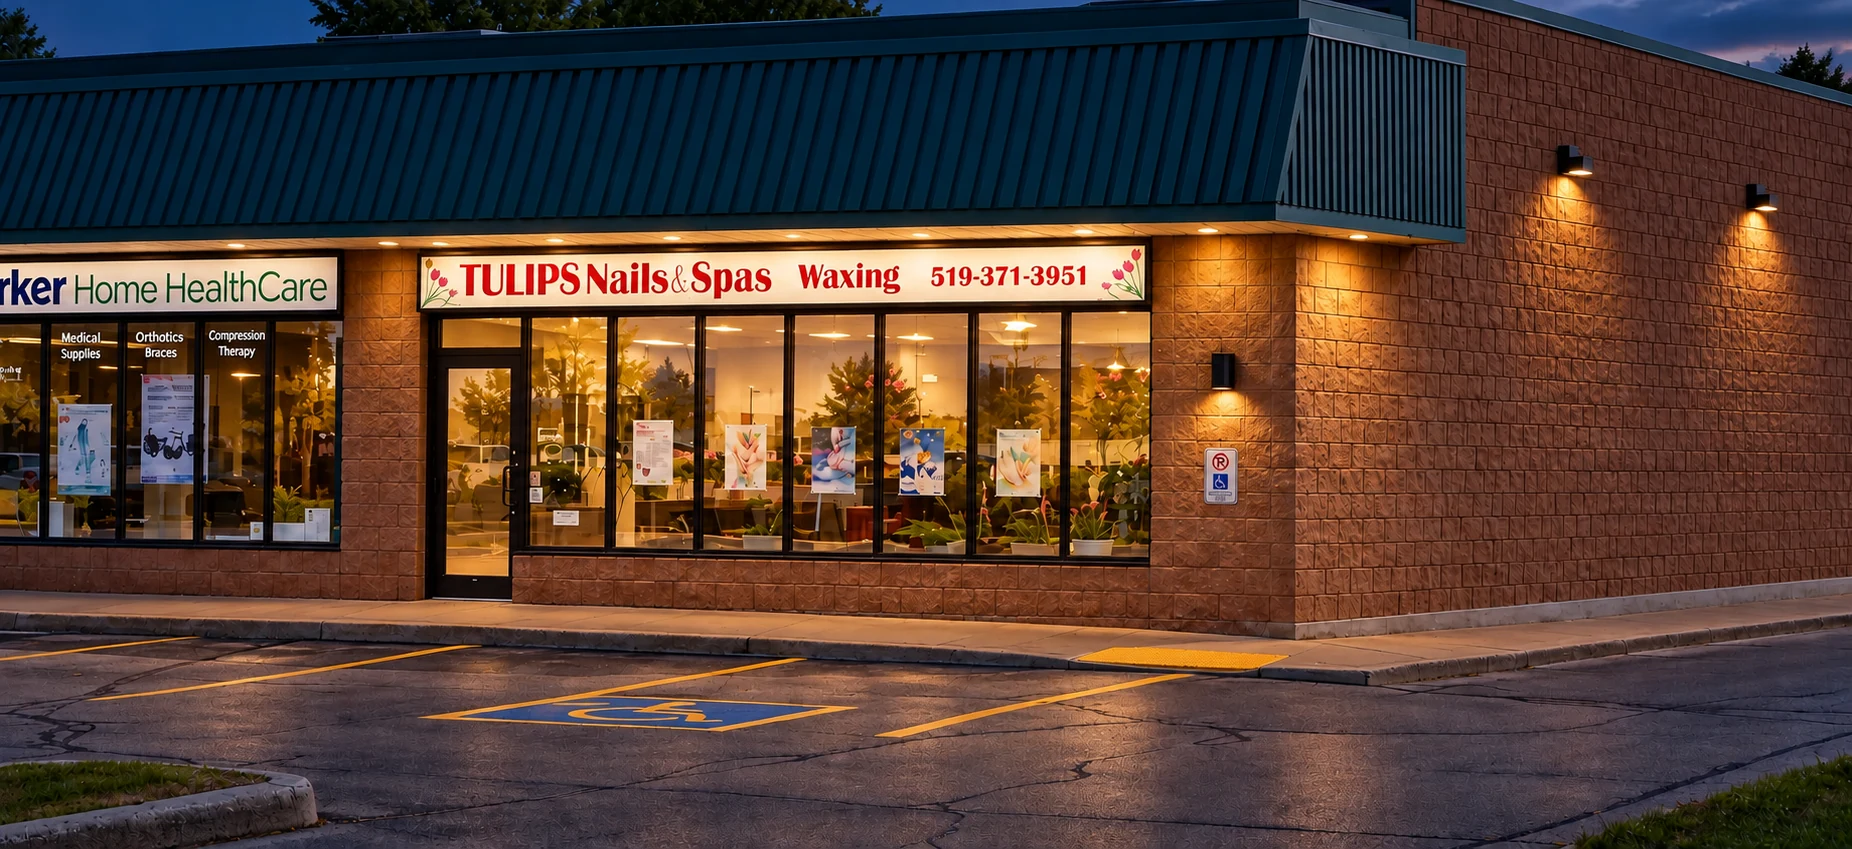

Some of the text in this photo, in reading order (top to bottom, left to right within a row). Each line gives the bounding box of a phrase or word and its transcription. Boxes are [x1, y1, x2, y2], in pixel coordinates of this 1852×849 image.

[459, 261, 581, 296] TULIPS
[586, 262, 669, 295] Nails
[690, 260, 772, 299] Spas
[798, 262, 901, 295] Waxing
[930, 265, 1087, 287] 519-371-3951
[74, 274, 157, 305] Home
[166, 270, 328, 304] HealthCare
[61, 332, 101, 344] Medical
[135, 331, 184, 343] Orthotics
[208, 330, 266, 342] Compression
[61, 348, 101, 361] Supplies
[145, 347, 178, 358] Braces
[218, 345, 256, 358] Therapy
